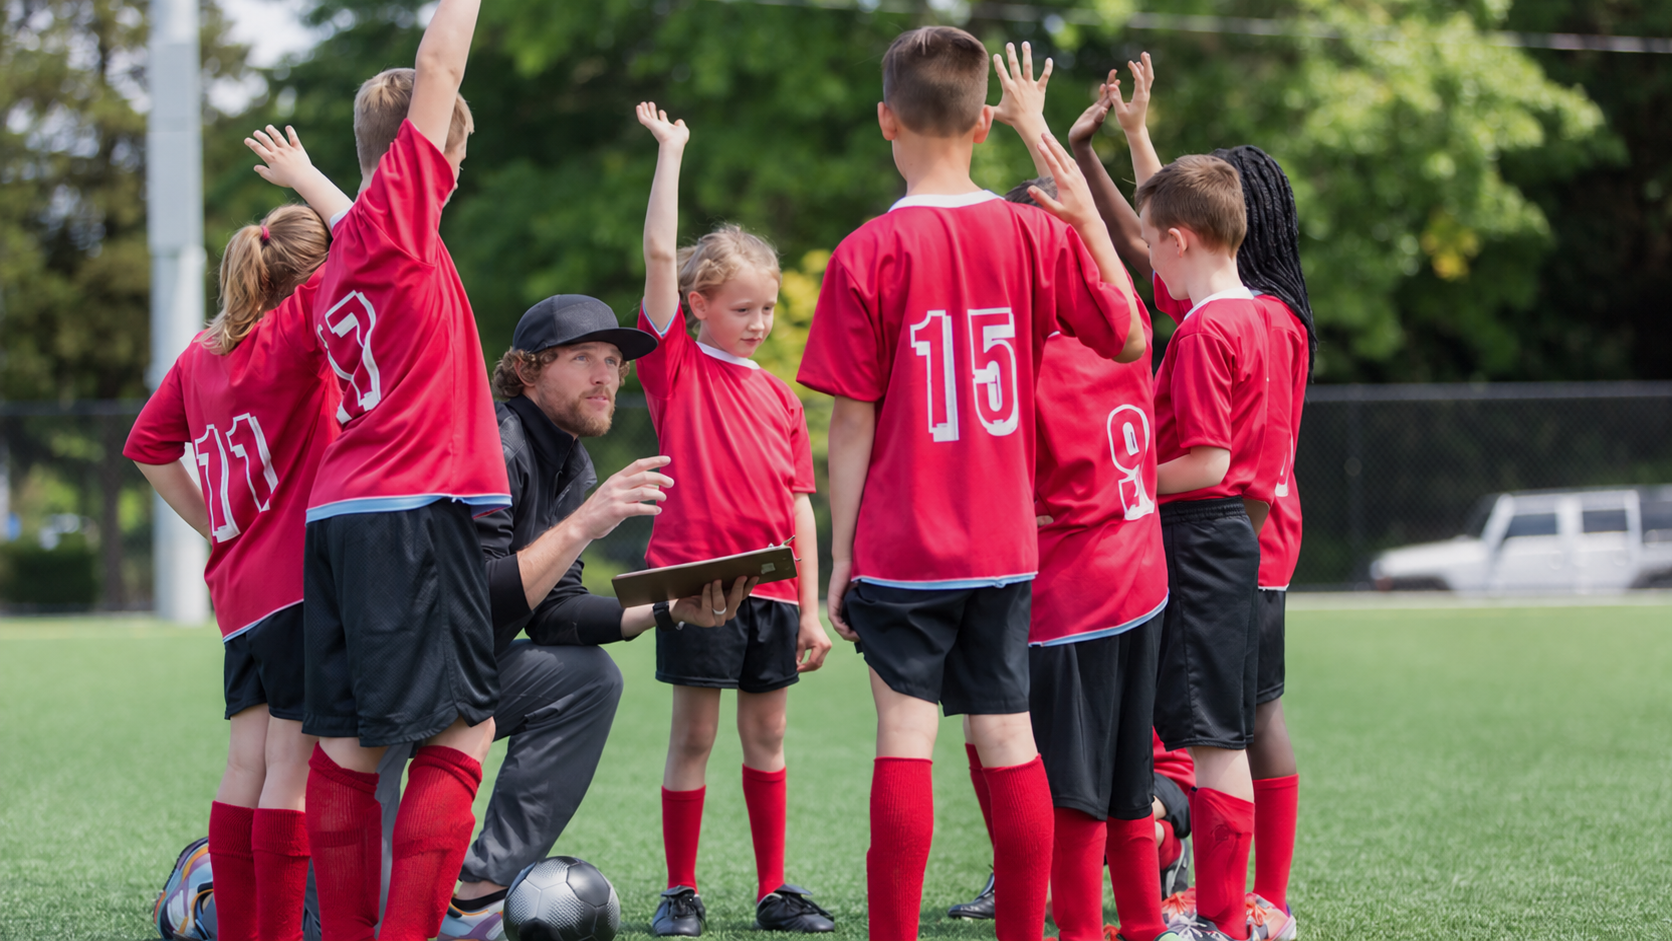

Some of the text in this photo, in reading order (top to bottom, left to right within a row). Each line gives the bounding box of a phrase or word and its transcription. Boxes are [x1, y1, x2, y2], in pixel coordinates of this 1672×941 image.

[910, 307, 1019, 442] 15
[194, 413, 279, 543] 11
[1107, 404, 1155, 520] 9
